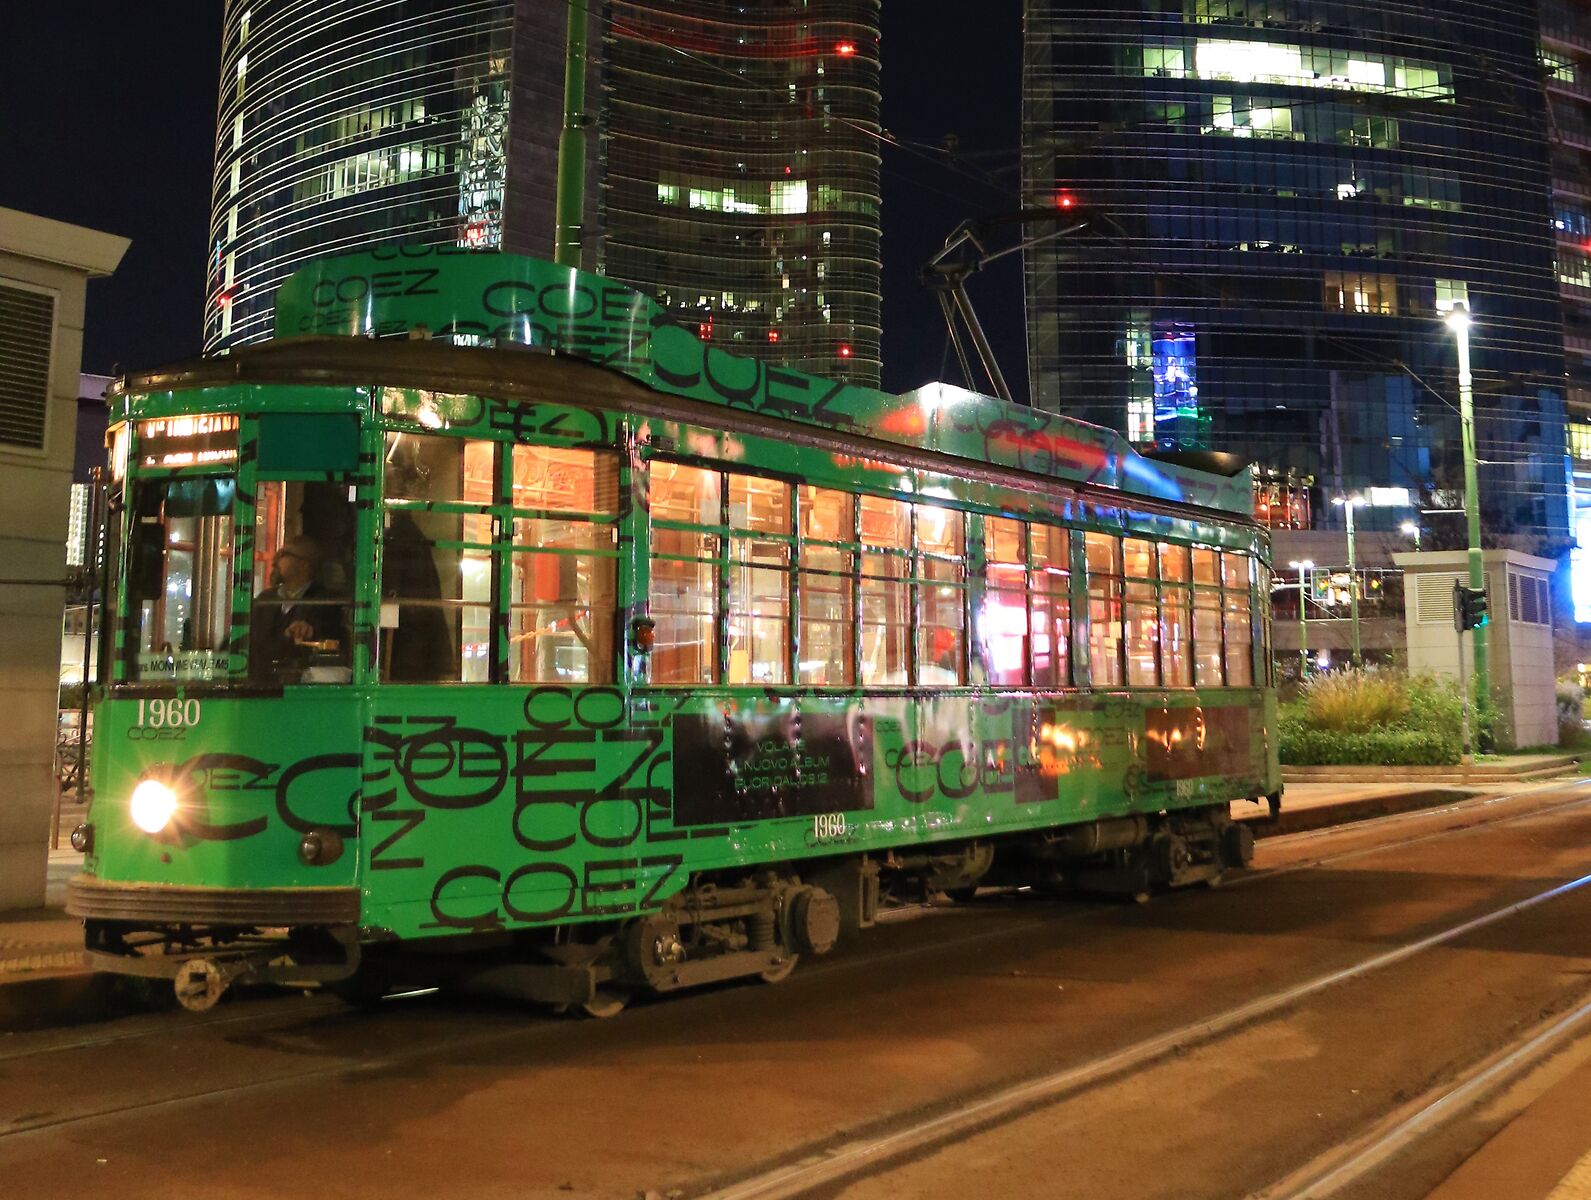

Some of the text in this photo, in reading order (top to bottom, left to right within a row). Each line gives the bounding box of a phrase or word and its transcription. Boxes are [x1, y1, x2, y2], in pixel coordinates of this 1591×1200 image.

[312, 268, 440, 308] COEZ
[138, 698, 201, 728] 1960
[127, 726, 187, 741] COEZ
[744, 757, 788, 772] NUOVO
[814, 813, 846, 838] 1960
